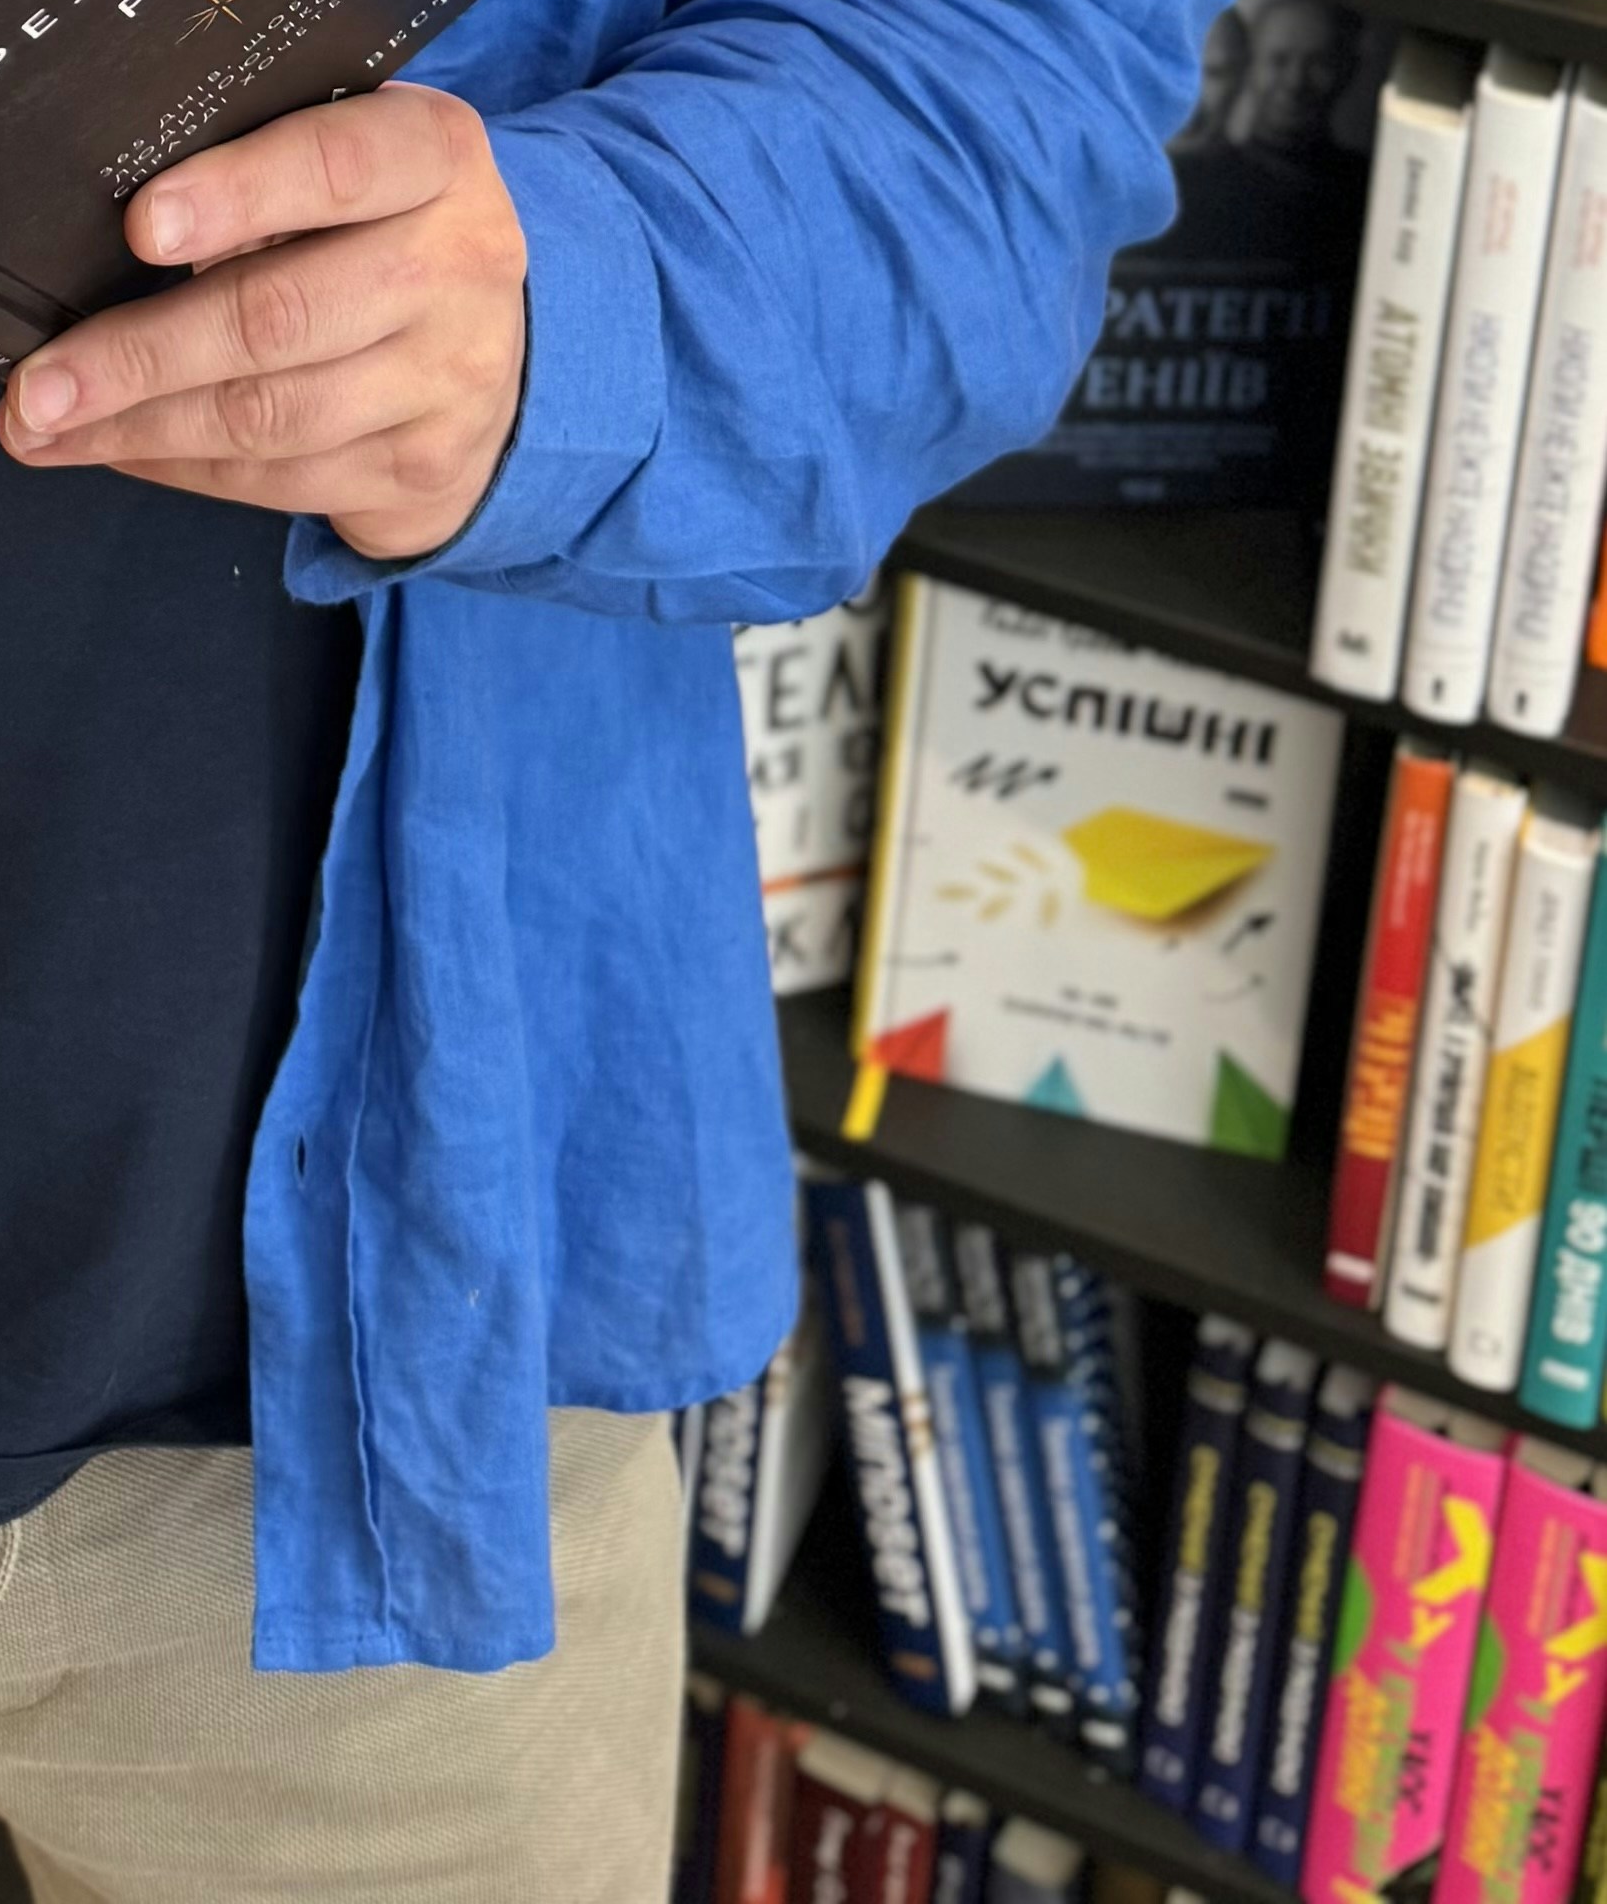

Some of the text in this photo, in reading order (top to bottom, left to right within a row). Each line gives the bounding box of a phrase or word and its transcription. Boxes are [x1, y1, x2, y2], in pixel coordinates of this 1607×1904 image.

[99, 139, 145, 178] 365
[160, 65, 232, 129] ДНІВ,
[244, 1, 301, 51] ЩОБ
[114, 98, 226, 198] СПРАВДІ
[116, 48, 270, 182] ЛЮДИНОЮ,
[1106, 287, 1332, 339] РАТЕГІЇ
[1085, 350, 1268, 408] ЕНІЇВ
[1348, 300, 1421, 578] АТОМНІ ЗВИЧКИ
[974, 661, 1276, 766] УСПІШНІ
[1551, 1199, 1607, 1343] 90 ДНІВ
